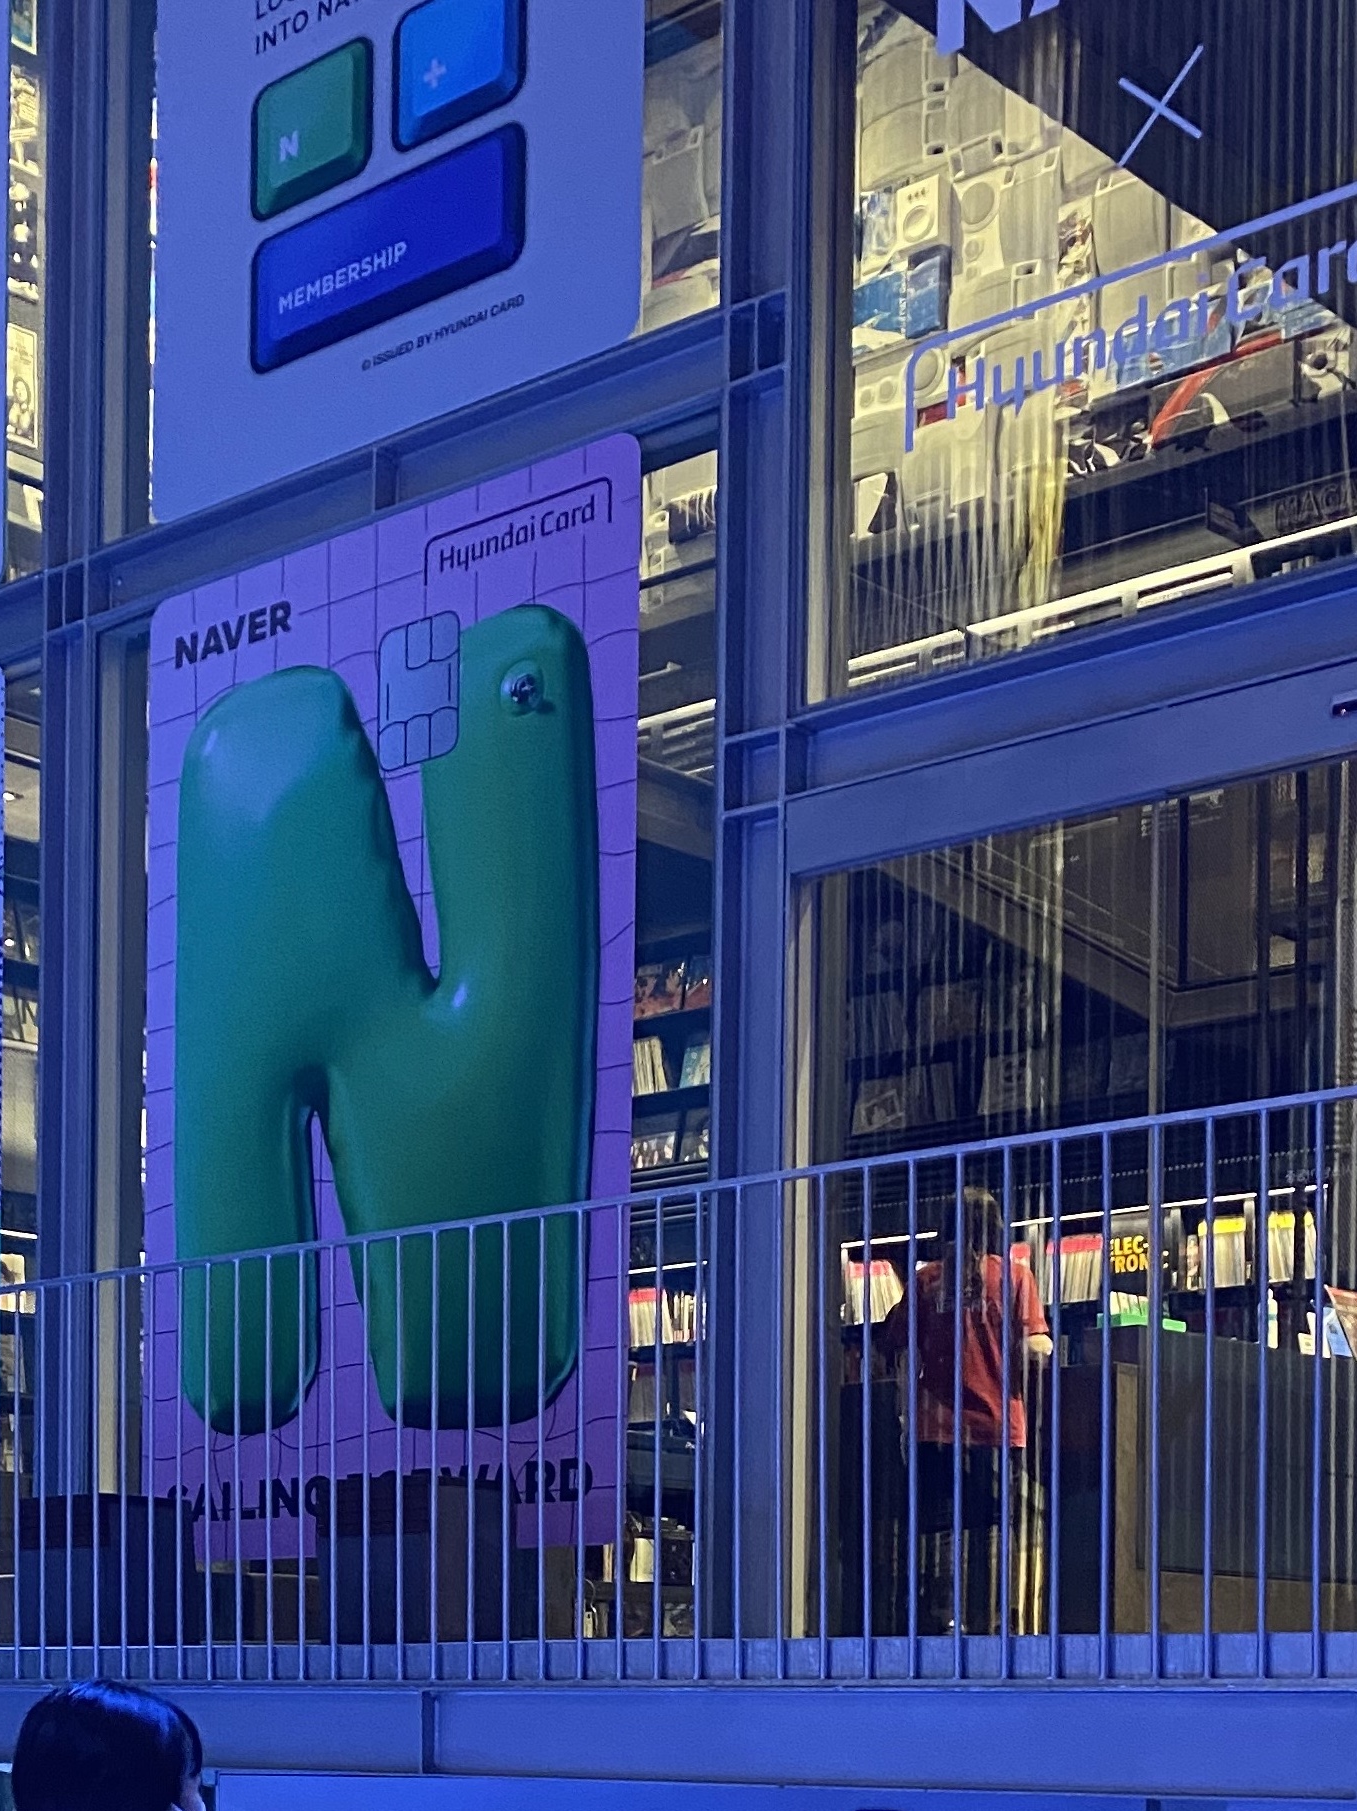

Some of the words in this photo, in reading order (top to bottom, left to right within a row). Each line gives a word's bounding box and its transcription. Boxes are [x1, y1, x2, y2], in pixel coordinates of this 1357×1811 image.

[255, 10, 310, 55] INTO
[256, 0, 294, 20] LO
[278, 129, 302, 164] N
[278, 241, 408, 315] MEMBERSHIP
[372, 340, 414, 366] ISSUED
[416, 331, 434, 350] BY
[434, 306, 489, 342] HYUNDAI
[490, 293, 526, 318] CARD
[947, 272, 1210, 420] Hyundai
[439, 515, 537, 574] Hyundai
[540, 494, 596, 538] Card
[173, 600, 293, 670] NAVER
